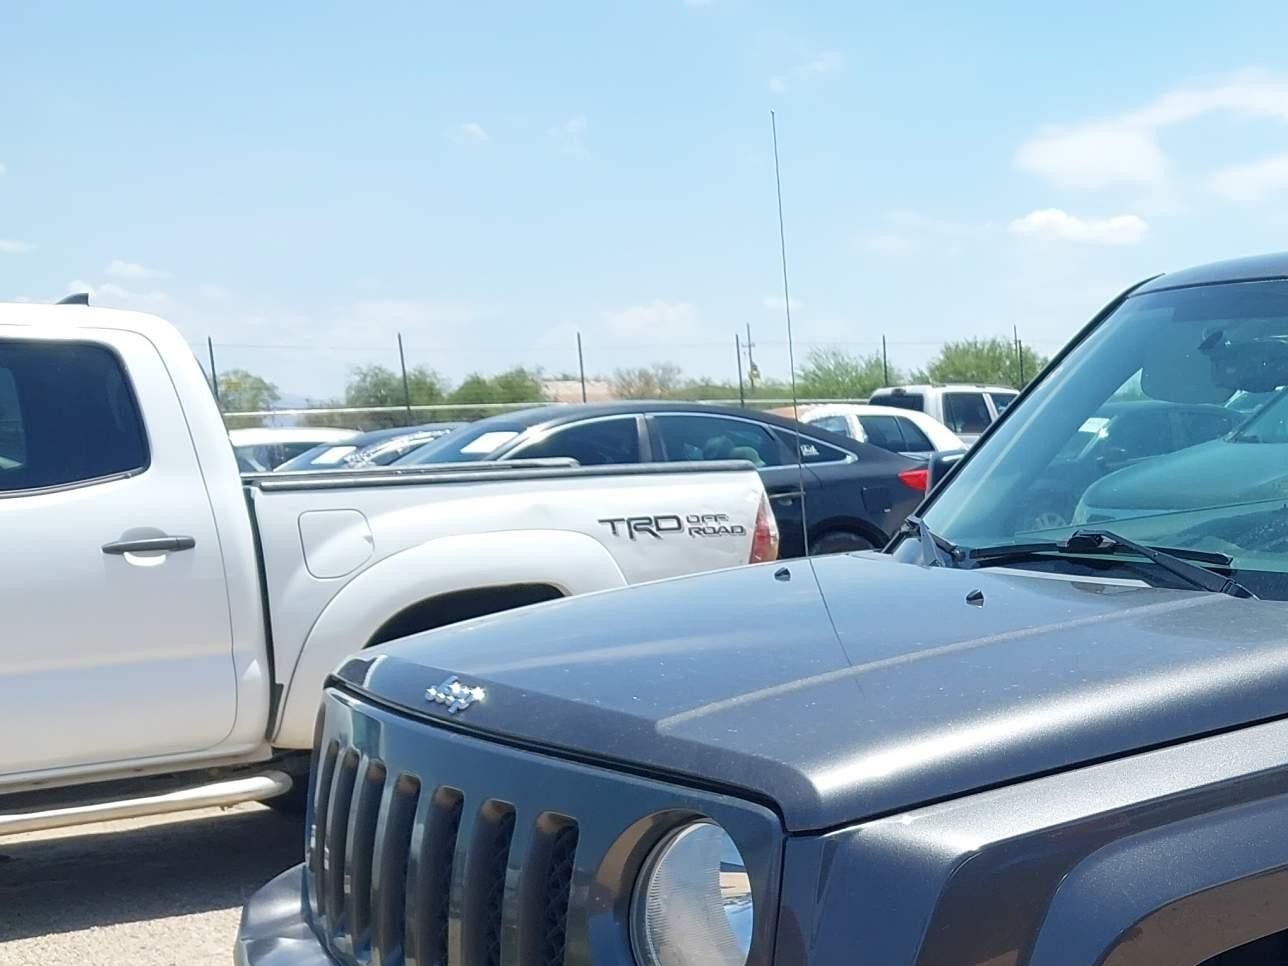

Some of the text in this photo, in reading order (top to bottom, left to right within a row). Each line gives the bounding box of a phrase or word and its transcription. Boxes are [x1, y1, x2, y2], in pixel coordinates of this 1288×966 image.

[598, 513, 729, 542] TRD OFF
[688, 525, 747, 537] ROAD
